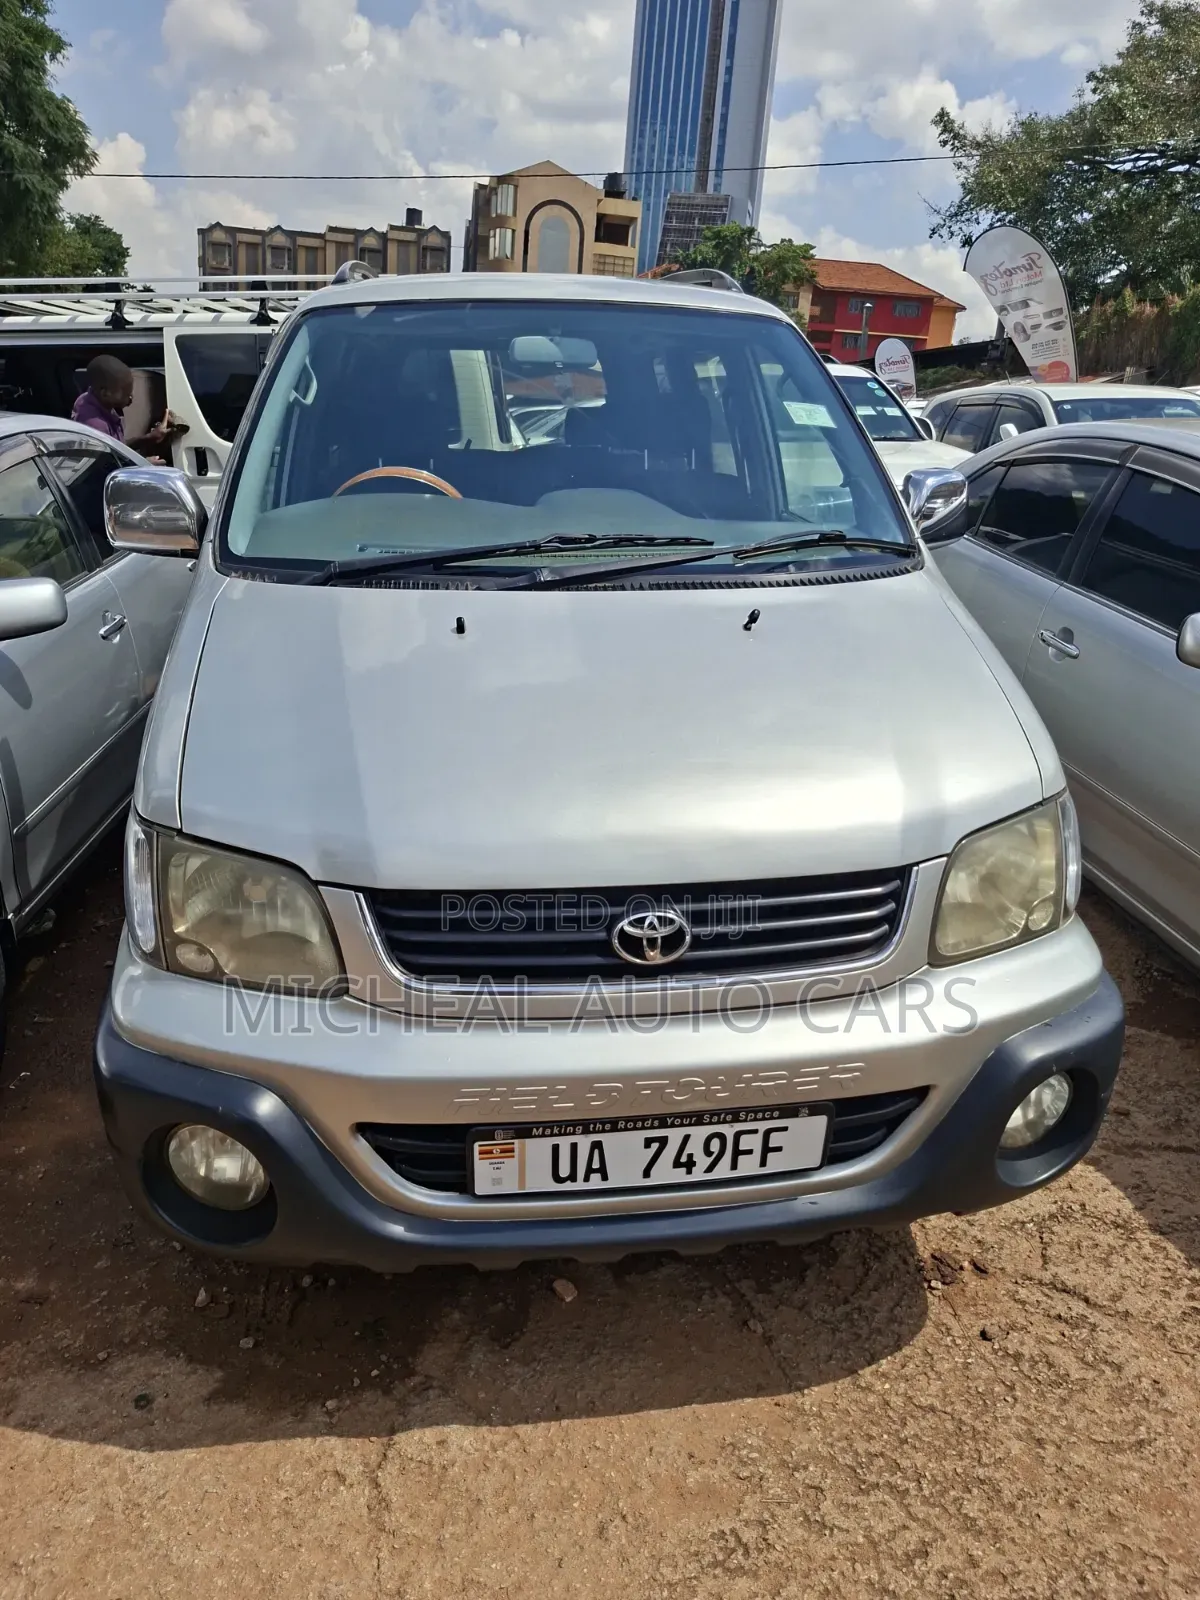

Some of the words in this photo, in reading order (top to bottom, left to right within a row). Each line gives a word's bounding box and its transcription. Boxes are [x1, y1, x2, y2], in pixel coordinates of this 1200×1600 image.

[532, 1126, 583, 1137] Making
[590, 1122, 611, 1132] the
[617, 1118, 660, 1129] Roads
[666, 1116, 697, 1126] Your
[703, 1112, 733, 1123] Safe
[739, 1109, 780, 1121] Space
[551, 1139, 609, 1184] UA
[642, 1126, 789, 1178] 749FF
